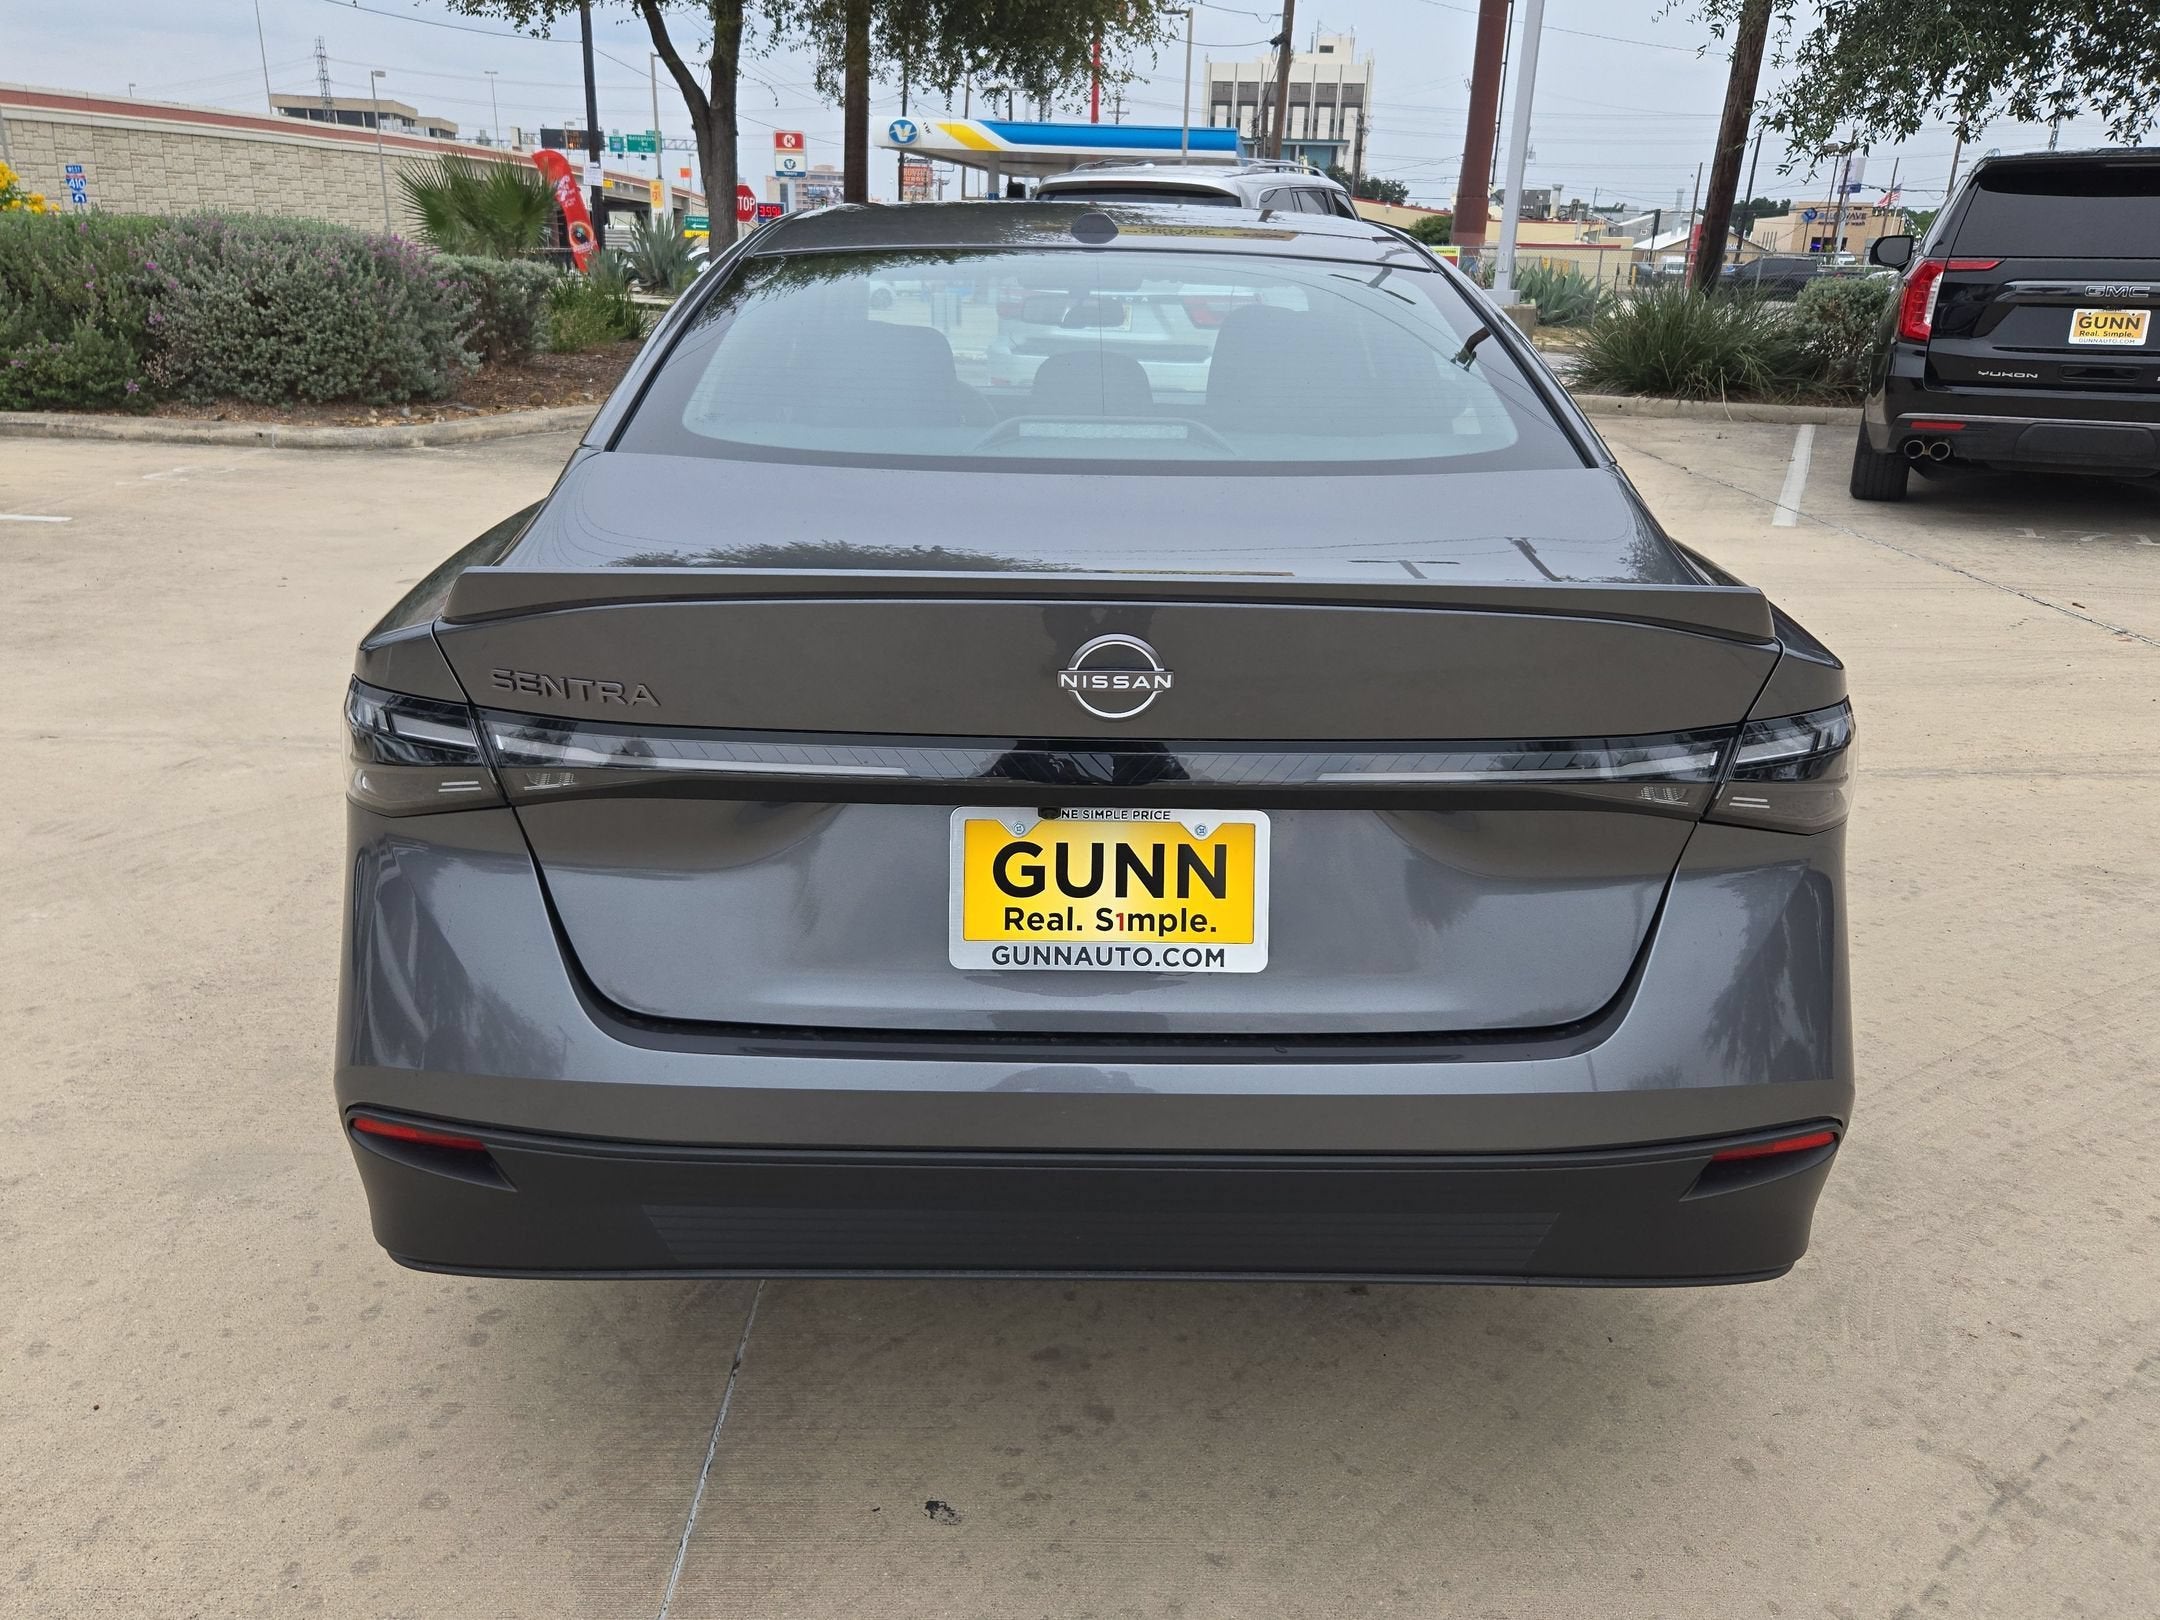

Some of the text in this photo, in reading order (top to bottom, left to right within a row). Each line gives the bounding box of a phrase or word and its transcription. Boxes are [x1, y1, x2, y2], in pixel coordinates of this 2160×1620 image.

[69, 178, 86, 189] 410
[737, 195, 756, 212] TOP
[2085, 285, 2151, 298] GMC
[2078, 316, 2141, 330] GUNN
[1978, 370, 2038, 379] YUKON
[490, 667, 661, 707] SENTRA
[1060, 673, 1172, 689] NISSAN
[1061, 809, 1171, 820] NE SIMPLE PRICE
[992, 841, 1228, 899] GUNN
[1004, 906, 1083, 932] Real.
[991, 945, 1225, 968] GUNNAUTO.COM
